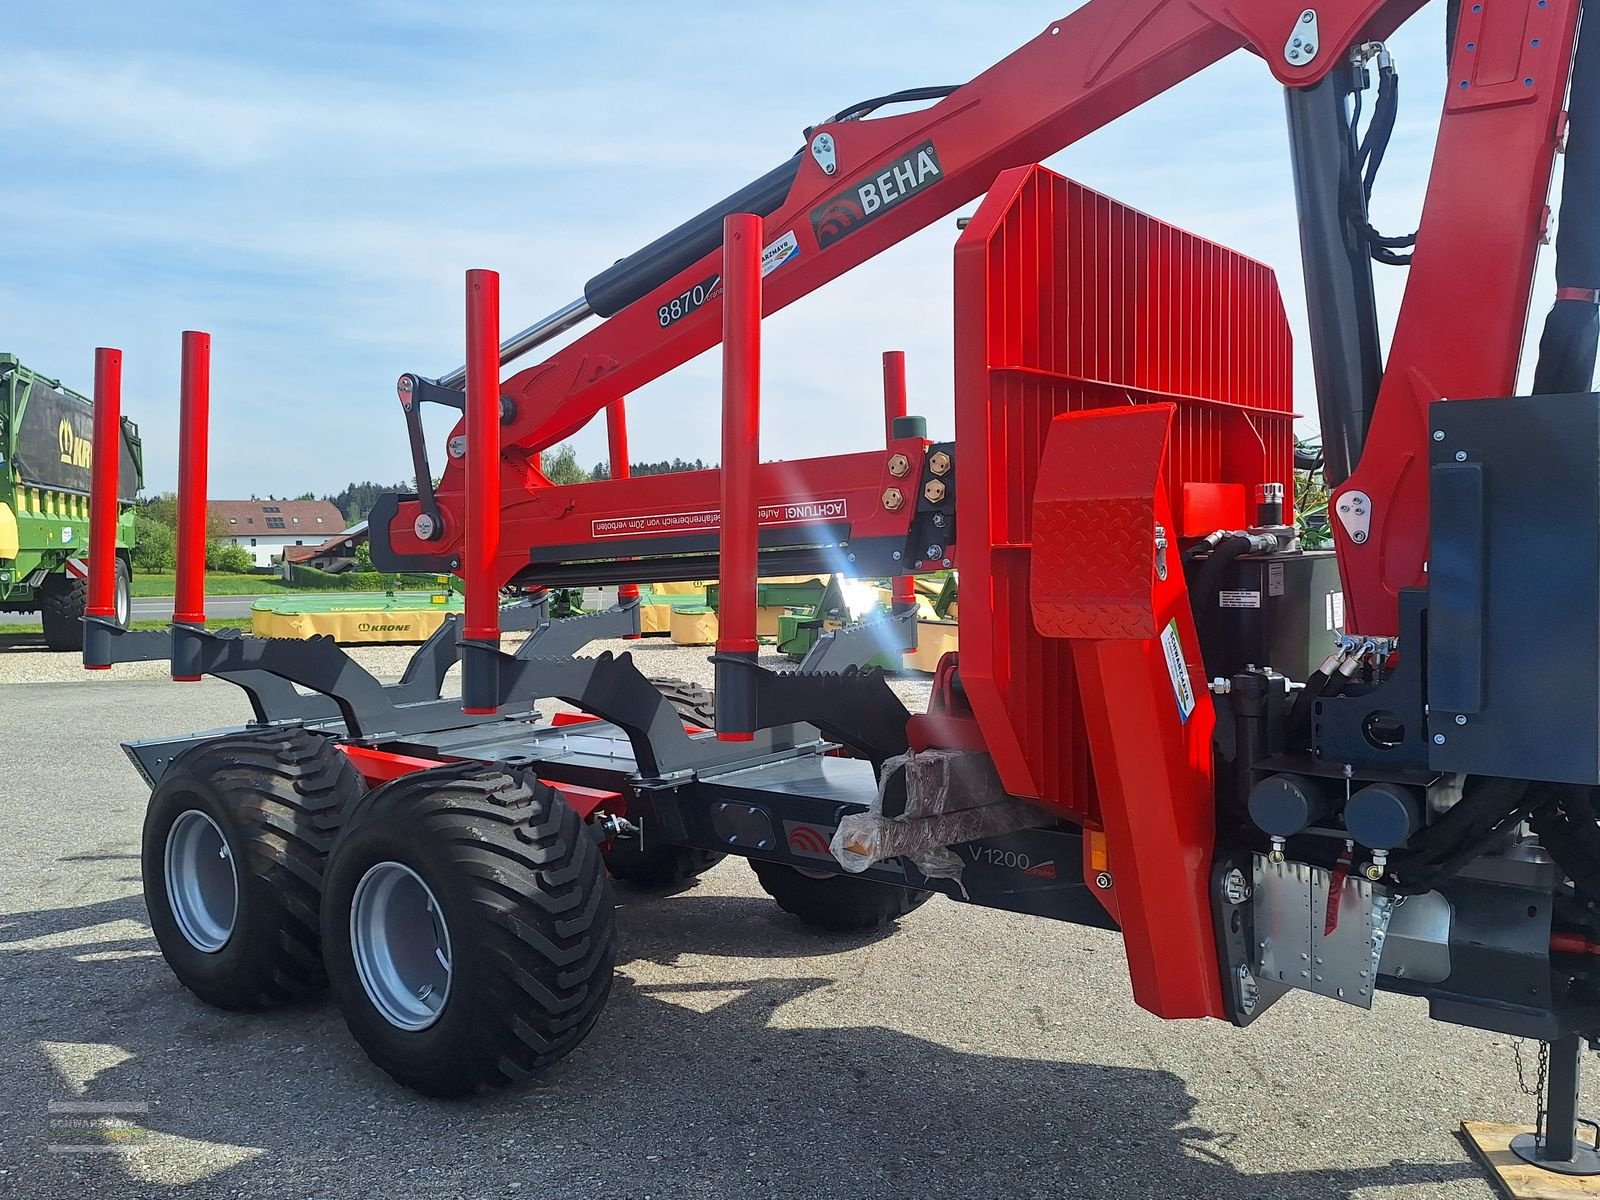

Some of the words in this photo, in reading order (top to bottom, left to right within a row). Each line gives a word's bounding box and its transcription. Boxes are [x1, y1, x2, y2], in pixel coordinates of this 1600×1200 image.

[762, 241, 788, 262] ARZMAYR
[659, 285, 704, 326] 8870
[73, 436, 92, 468] KR
[785, 502, 842, 519] ACHTUNG!
[596, 522, 627, 531] verboten
[629, 519, 645, 529] 20m
[371, 624, 411, 632] KRONE
[968, 844, 1030, 870] V1200
